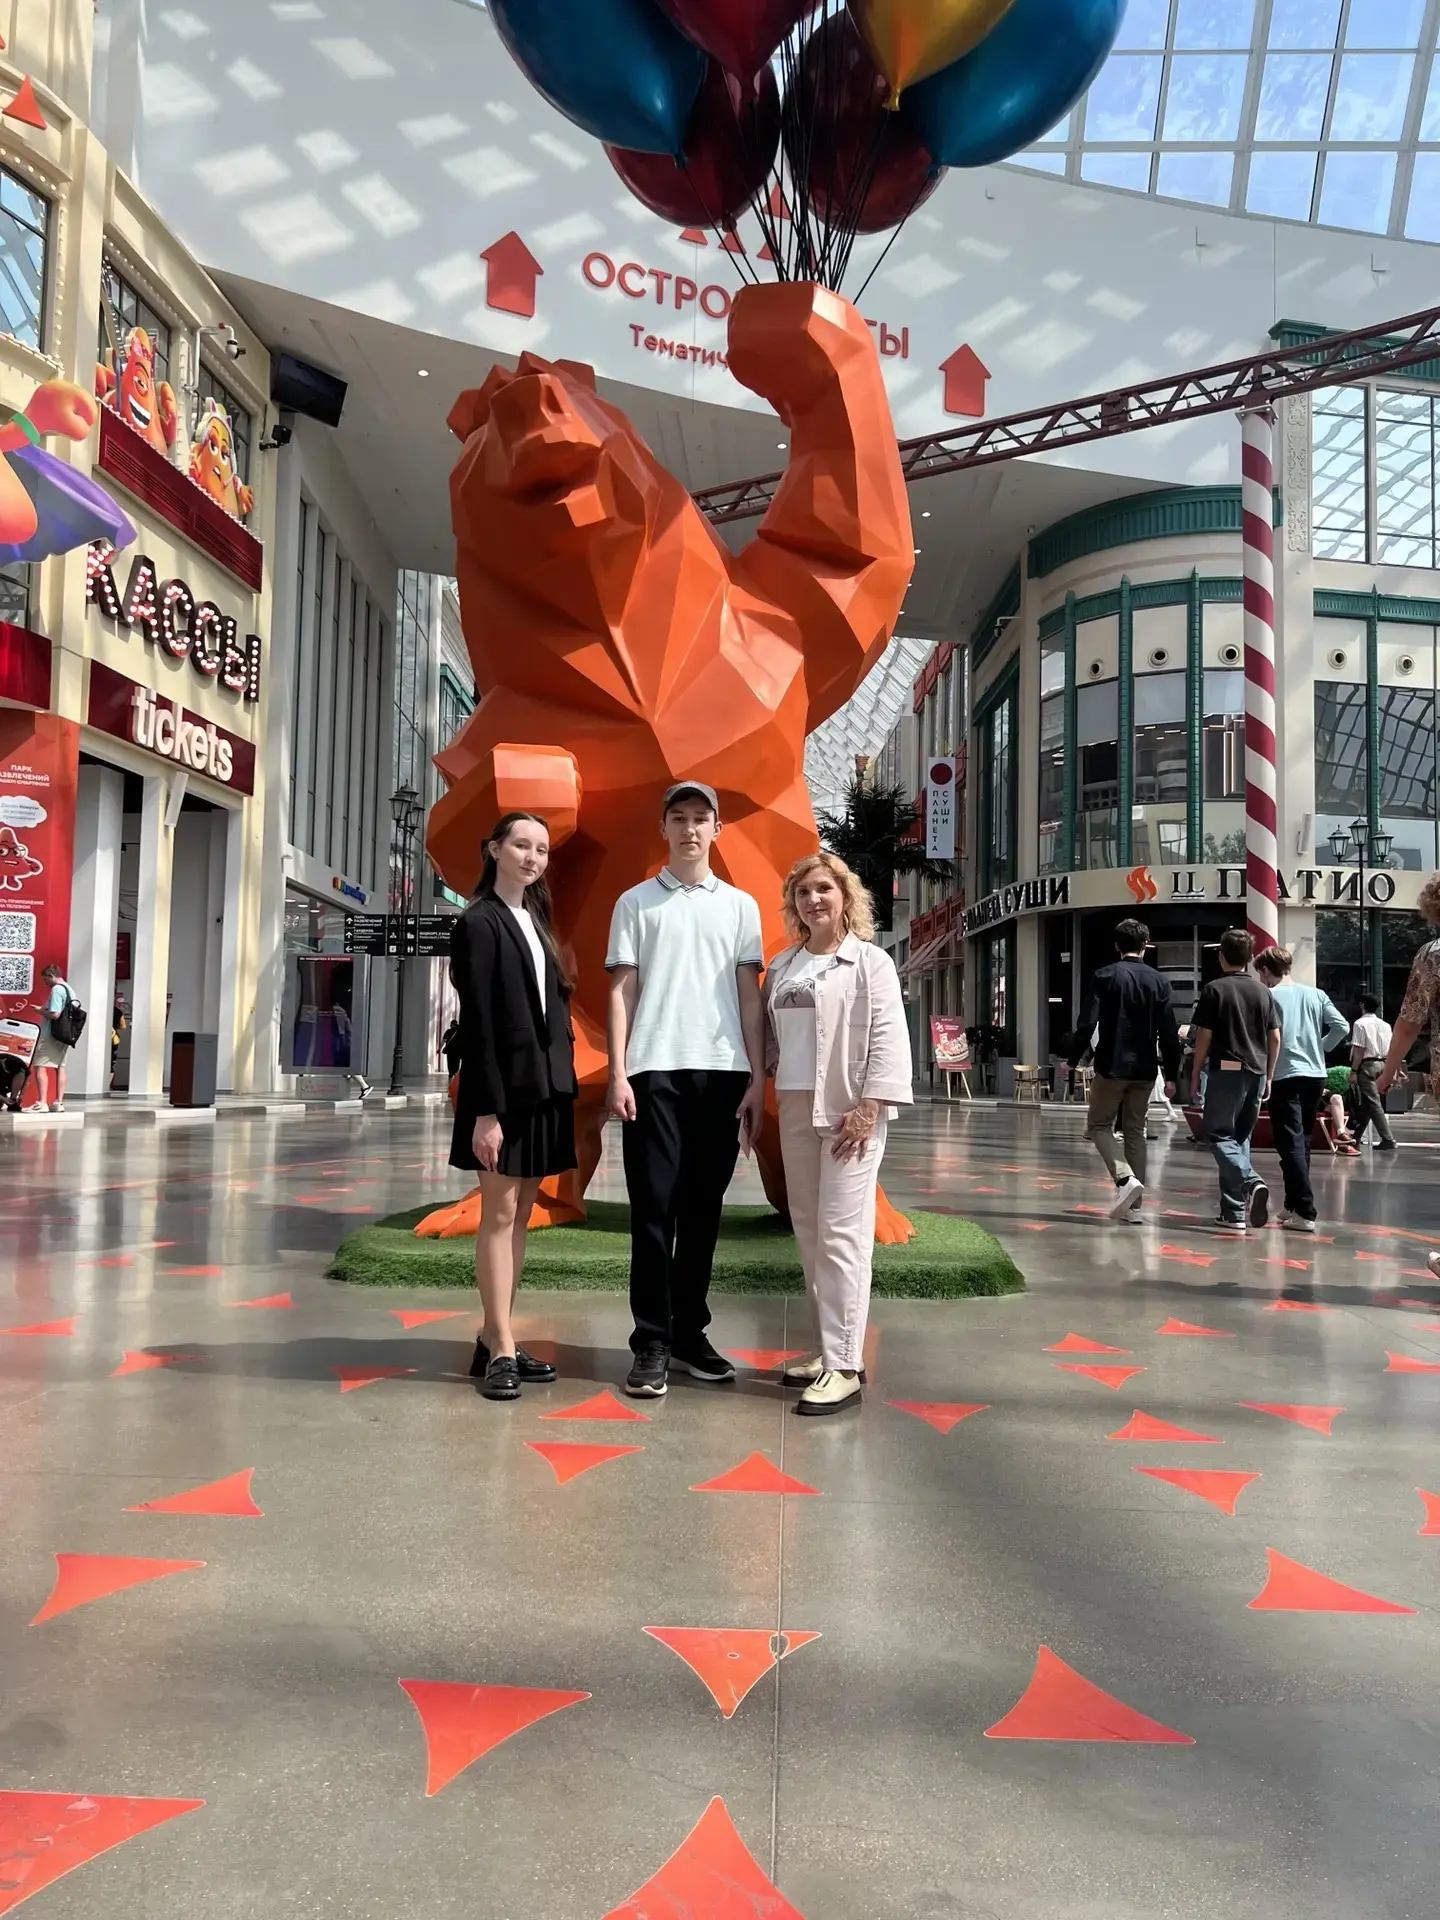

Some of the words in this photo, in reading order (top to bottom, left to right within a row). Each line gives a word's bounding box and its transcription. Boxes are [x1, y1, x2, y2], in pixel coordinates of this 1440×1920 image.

[582, 252, 736, 319] ОСТРО
[629, 323, 730, 369] Тематич
[86, 538, 262, 703] КАССЫ
[132, 686, 234, 782] tickets
[0, 771, 50, 782] АЗВЛЕЧЕНИЙ
[10, 764, 33, 773] ПАРК
[931, 790, 939, 852] ПЛАНЕТА
[940, 790, 950, 825] СУШИ
[1004, 876, 1070, 915] СУШИ
